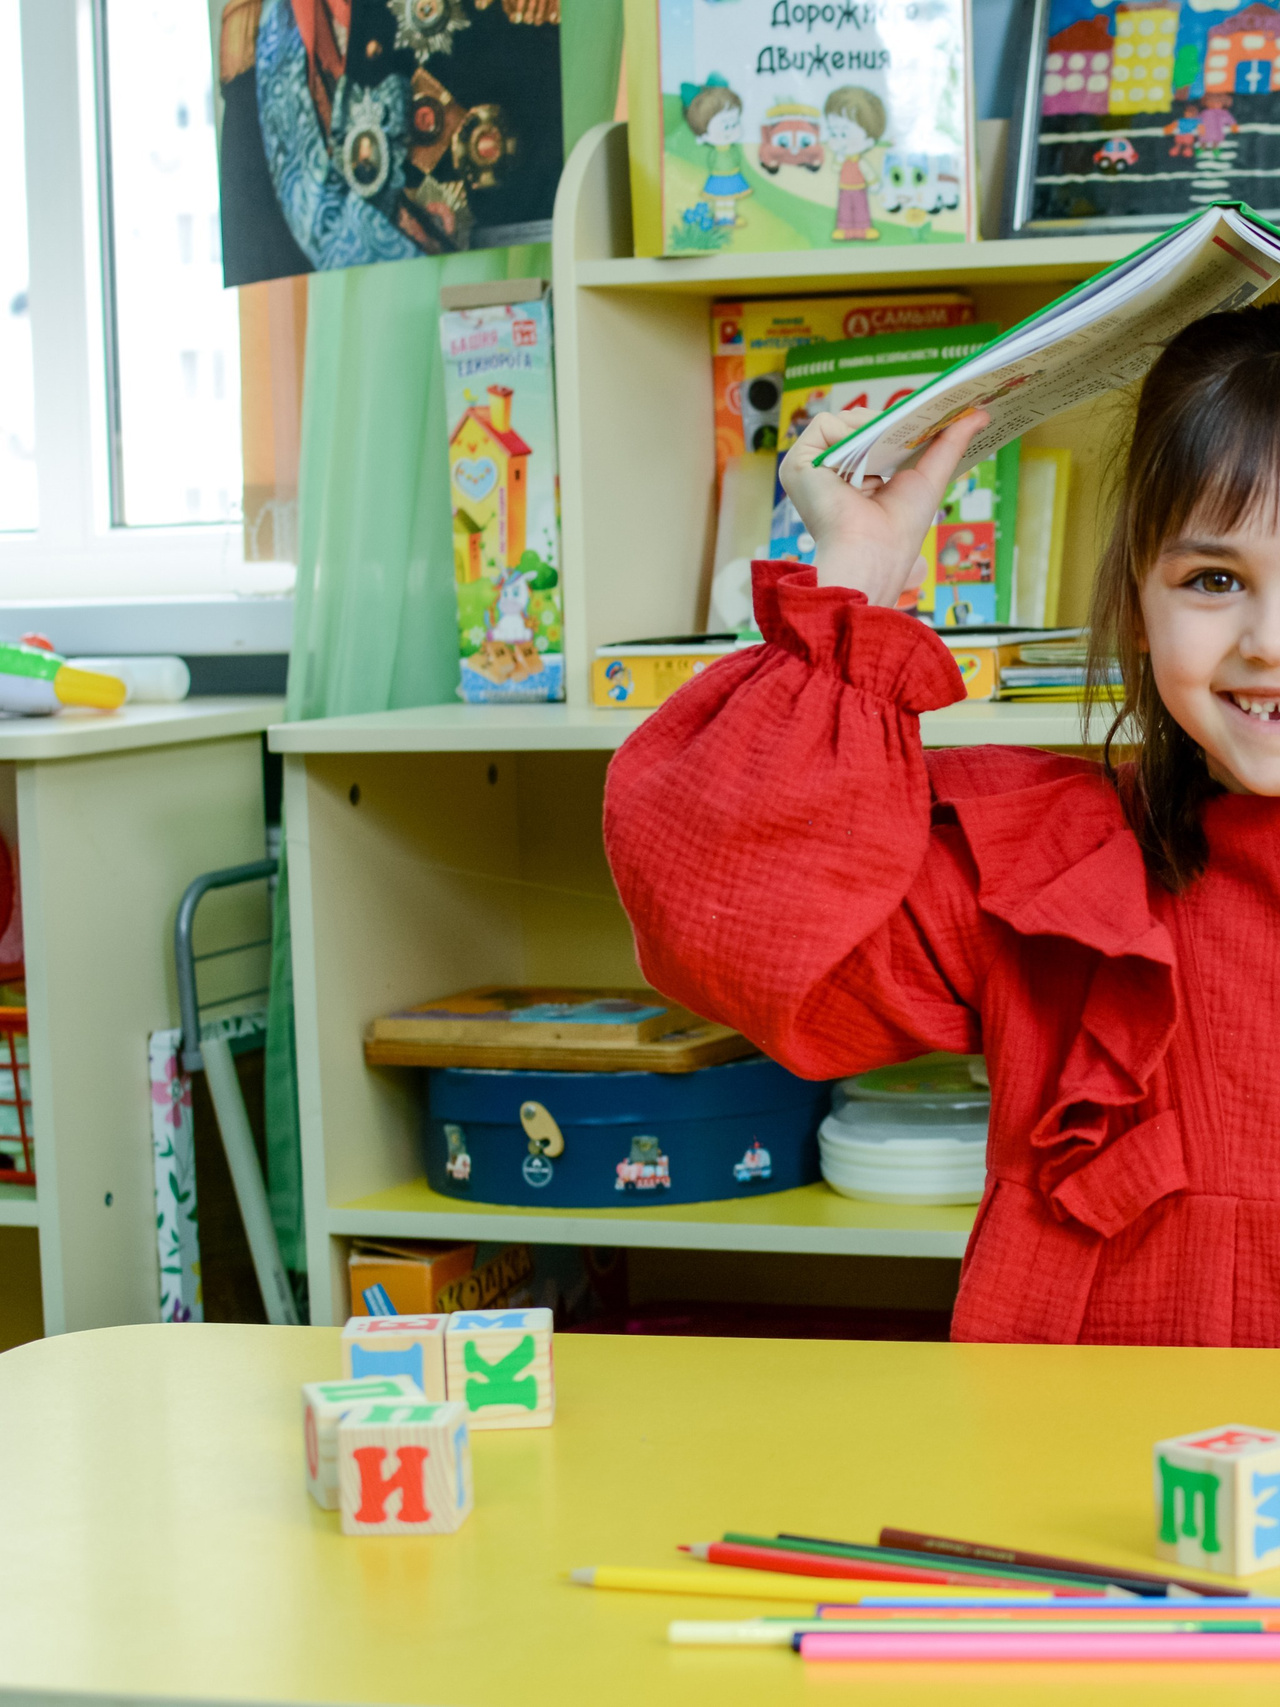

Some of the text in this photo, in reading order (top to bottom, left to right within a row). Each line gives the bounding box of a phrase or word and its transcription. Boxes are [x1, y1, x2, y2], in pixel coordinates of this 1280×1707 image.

[771, 0, 918, 33] Дорожно
[756, 43, 891, 77] Движения
[464, 1334, 538, 1413] К
[353, 1445, 432, 1524] И
